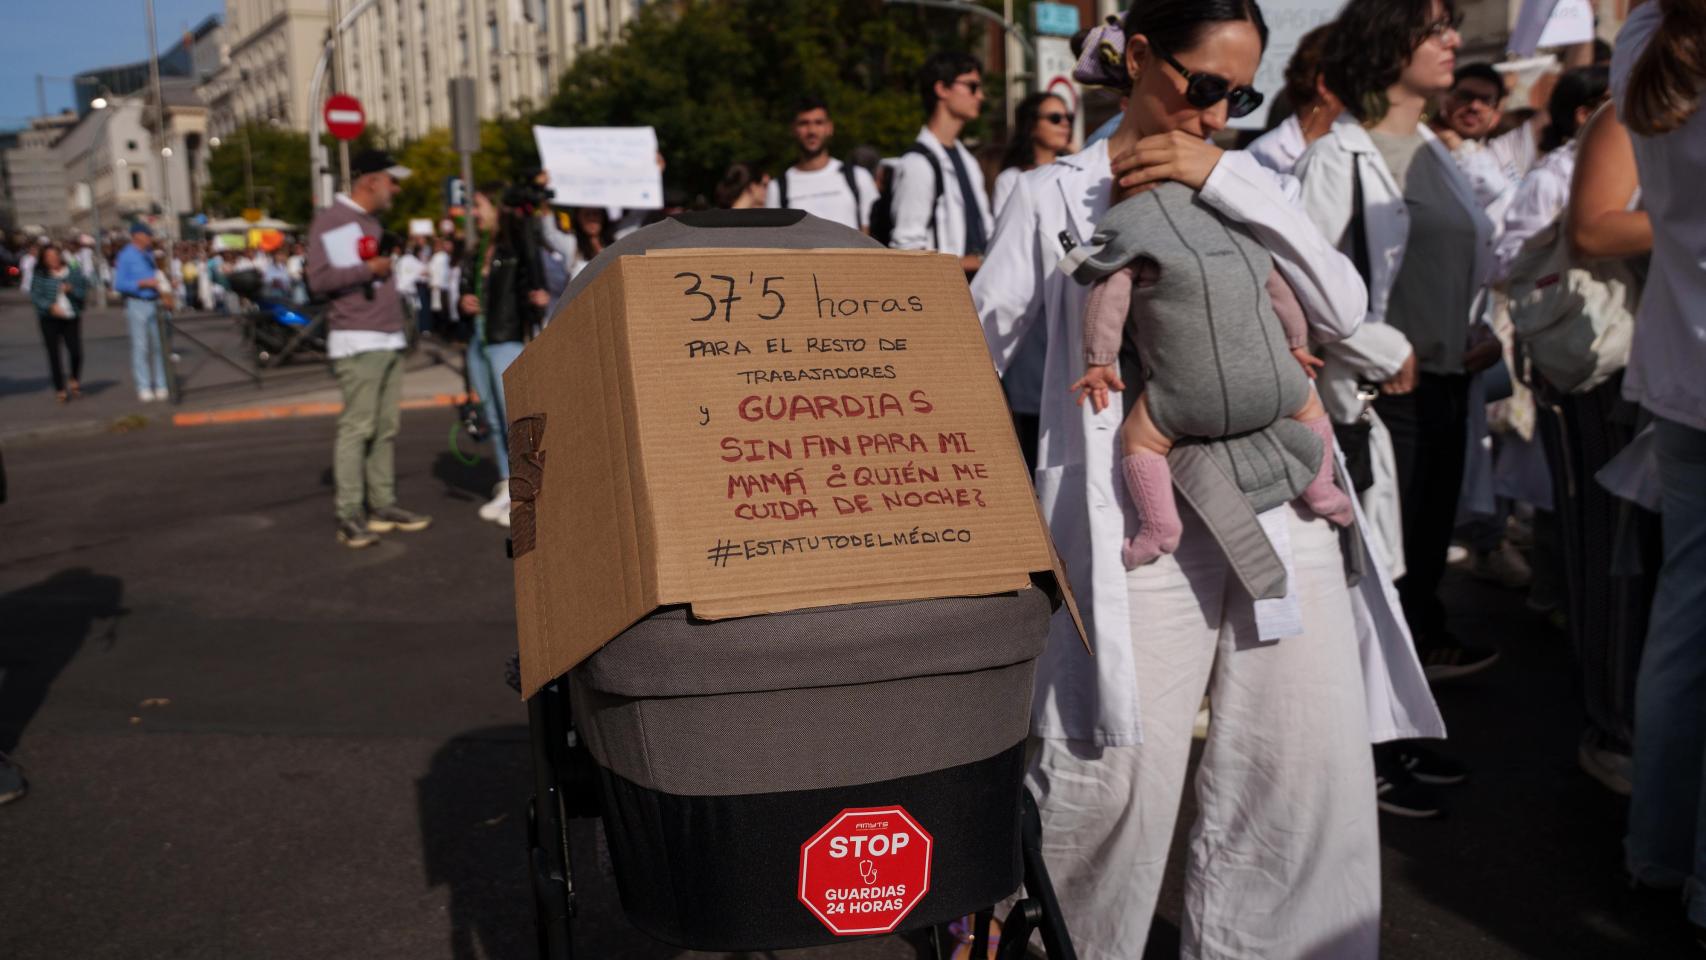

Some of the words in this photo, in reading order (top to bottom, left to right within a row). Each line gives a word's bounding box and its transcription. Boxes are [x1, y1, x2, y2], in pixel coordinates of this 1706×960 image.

[673, 270, 786, 323] 37'5
[812, 273, 923, 319] horas
[684, 339, 752, 359] PARA
[766, 337, 793, 354] EL
[806, 337, 867, 353] RESTO
[878, 337, 907, 352] DE
[737, 364, 897, 385] TRABAJADORES
[699, 405, 711, 426] y
[738, 389, 934, 423] GUARDIAS
[720, 436, 793, 463] SIN
[801, 434, 852, 459] FIN
[856, 432, 929, 457] PARA
[937, 432, 976, 454] MI
[727, 467, 807, 499] MAMÁ
[951, 463, 989, 481] ME
[734, 499, 818, 521] CUIDA
[832, 494, 873, 515] DE
[881, 487, 986, 511] NOCHE?
[707, 526, 972, 568] #ESTATUTODELMÉDICO
[828, 832, 910, 858] STOP
[824, 884, 906, 901] GUARDIAS
[826, 902, 845, 915] 24
[849, 898, 903, 914] HORAS
